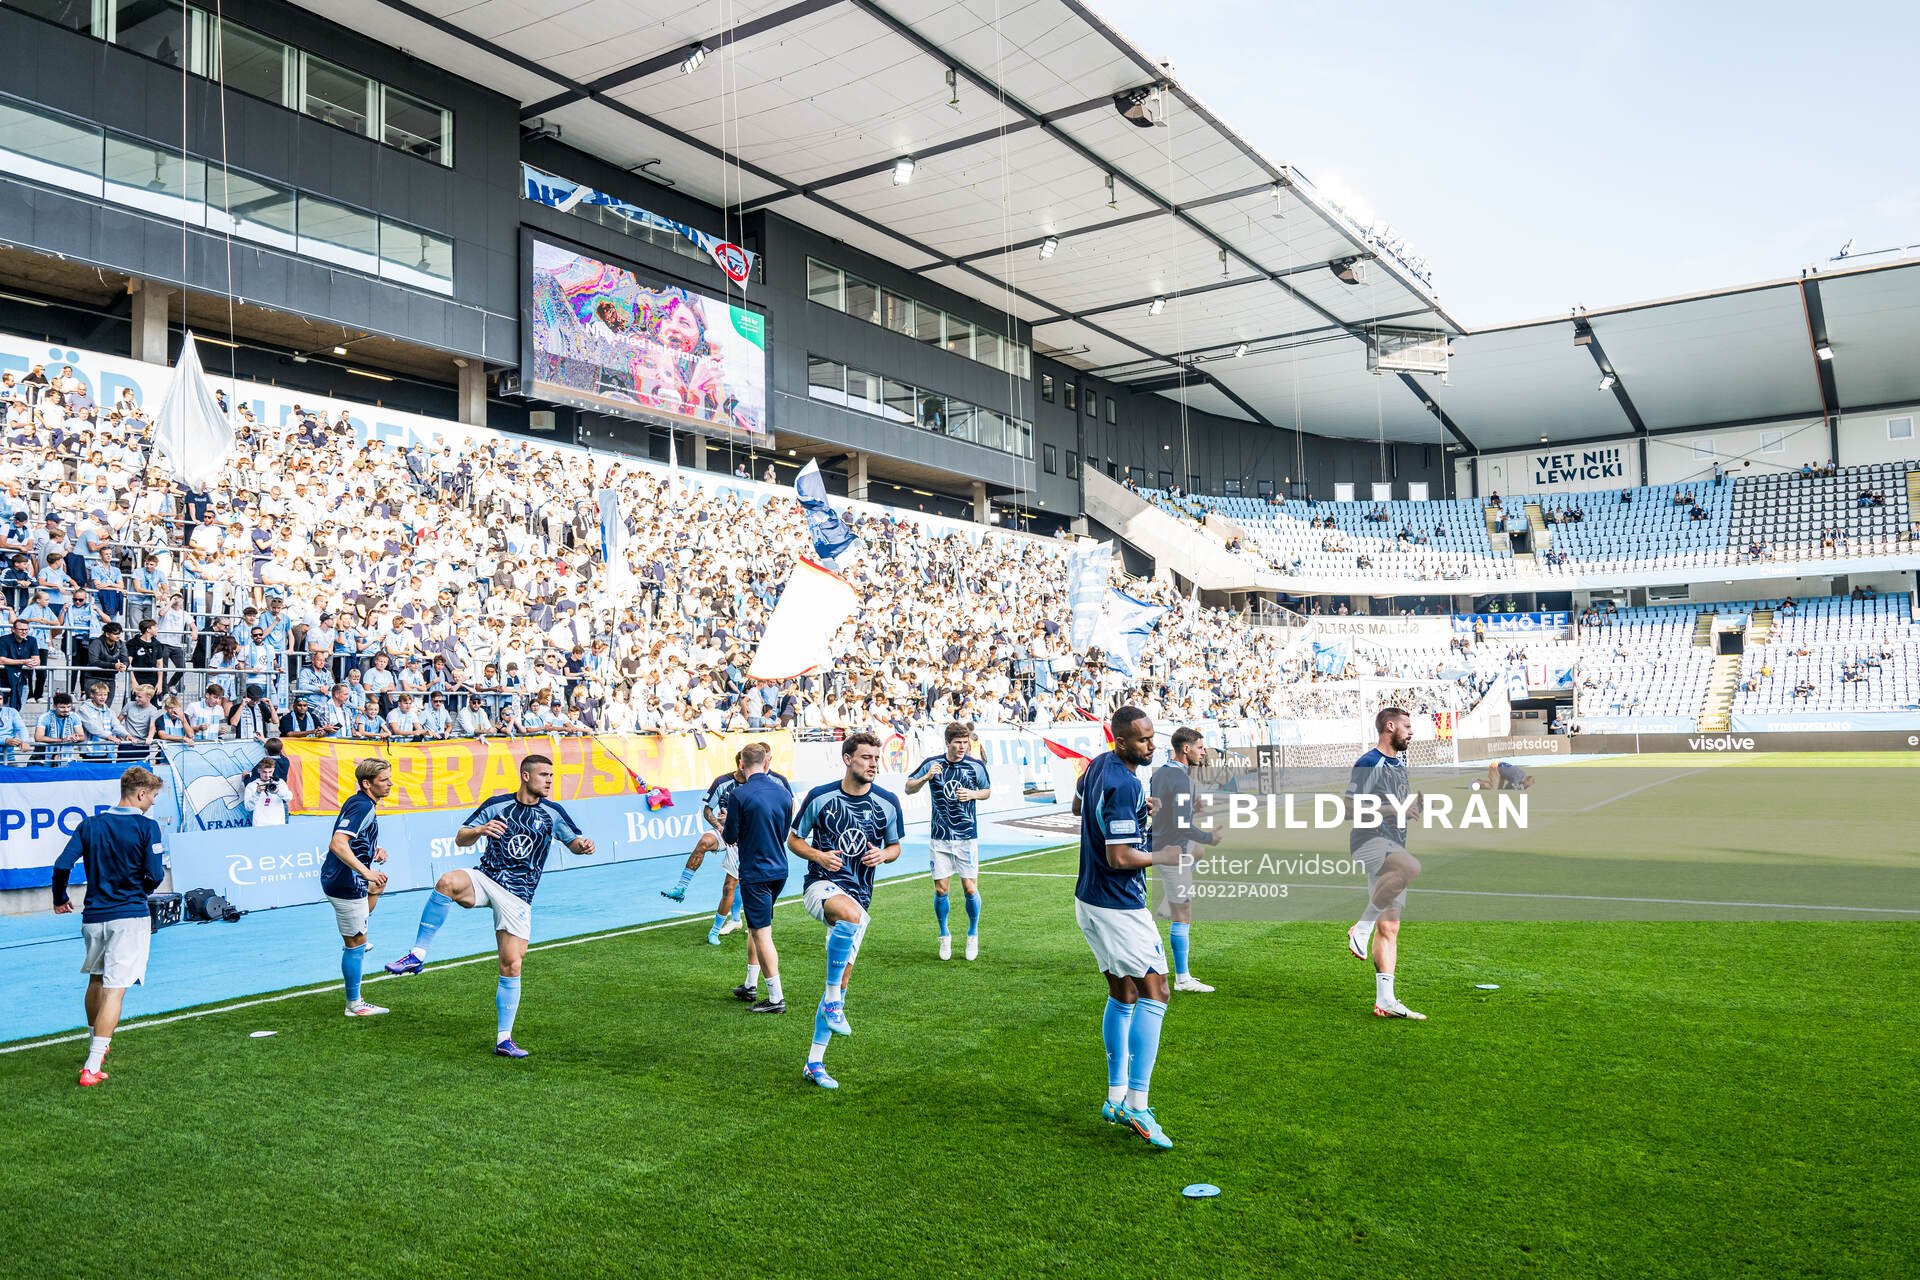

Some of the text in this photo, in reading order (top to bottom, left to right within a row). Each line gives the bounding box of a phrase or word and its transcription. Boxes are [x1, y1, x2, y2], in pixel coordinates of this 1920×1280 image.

[1536, 448, 1620, 469] VET NI!!
[1535, 462, 1623, 485] LEWICKI
[1688, 734, 1755, 751] visolve
[260, 873, 294, 884] PRINT
